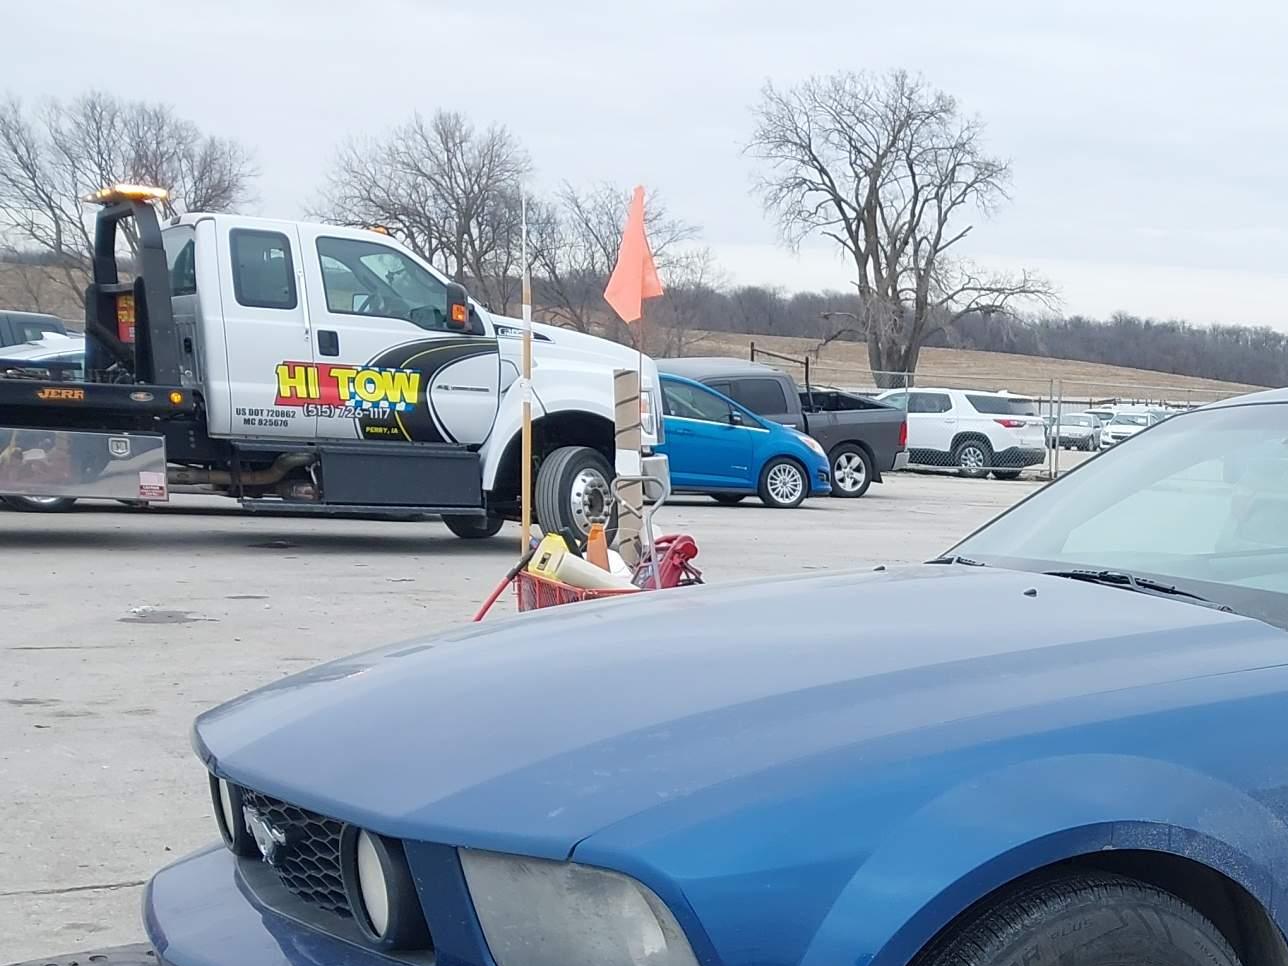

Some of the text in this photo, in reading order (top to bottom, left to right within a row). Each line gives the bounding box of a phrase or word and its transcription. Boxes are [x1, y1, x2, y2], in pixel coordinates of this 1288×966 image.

[275, 363, 421, 404] HI TOW
[235, 407, 247, 416] US
[248, 408, 264, 417] DOT
[302, 403, 391, 420] (515) 726-1117
[243, 417, 256, 426] MC
